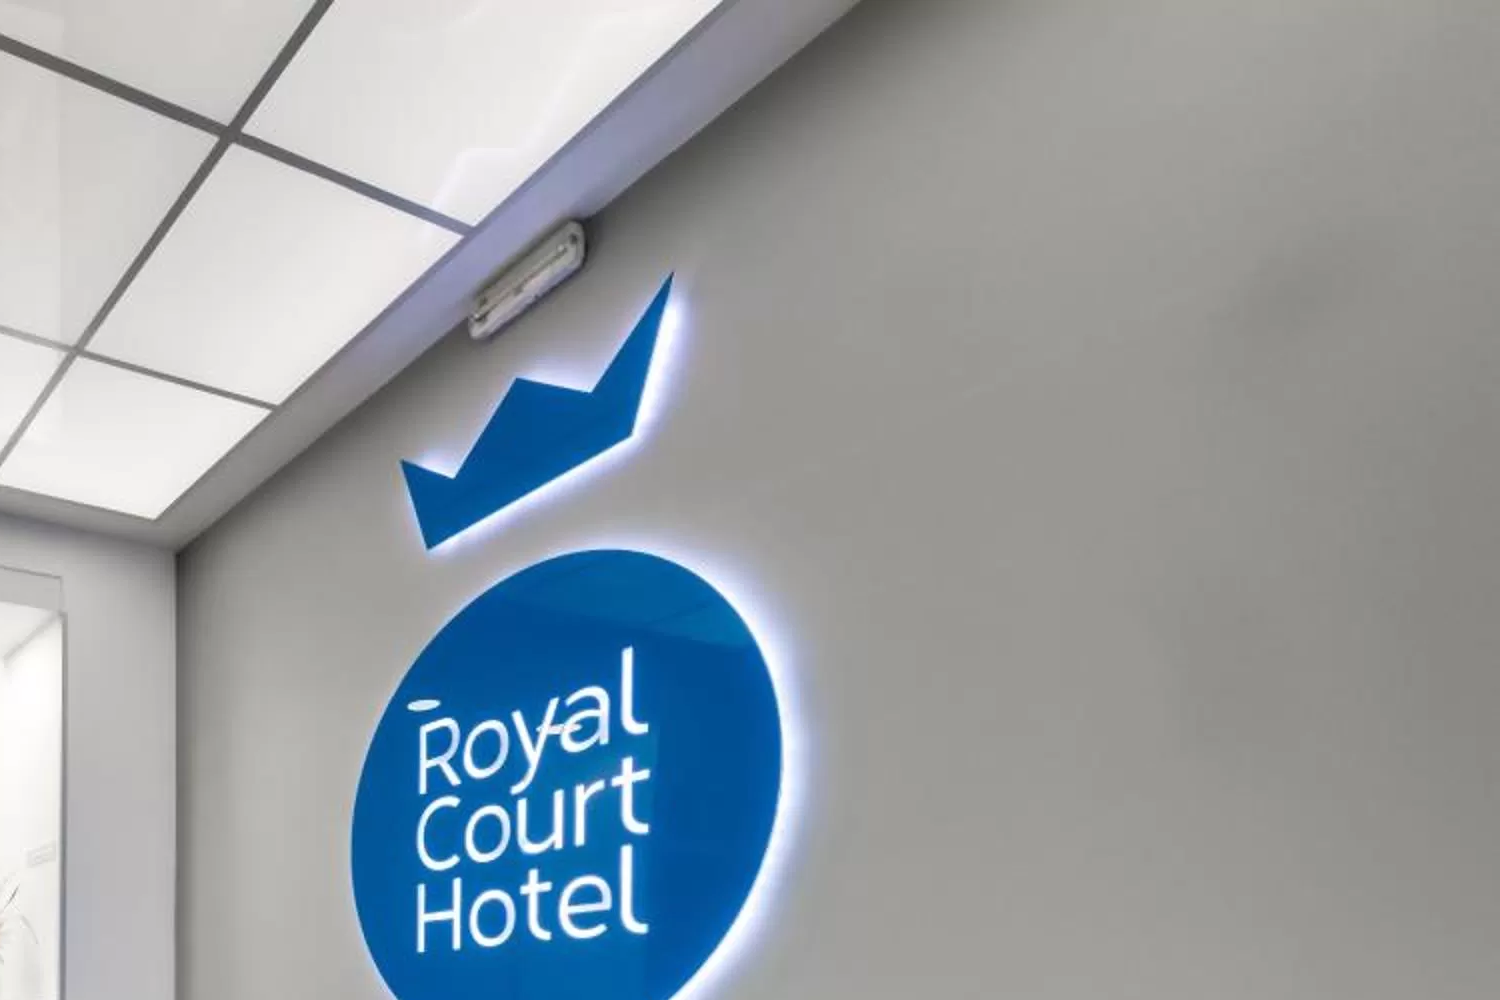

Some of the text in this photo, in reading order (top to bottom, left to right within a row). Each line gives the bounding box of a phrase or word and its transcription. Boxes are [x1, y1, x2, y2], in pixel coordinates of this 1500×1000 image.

[417, 646, 649, 796] Royal
[416, 756, 650, 871] Court
[416, 844, 649, 953] Hotel
